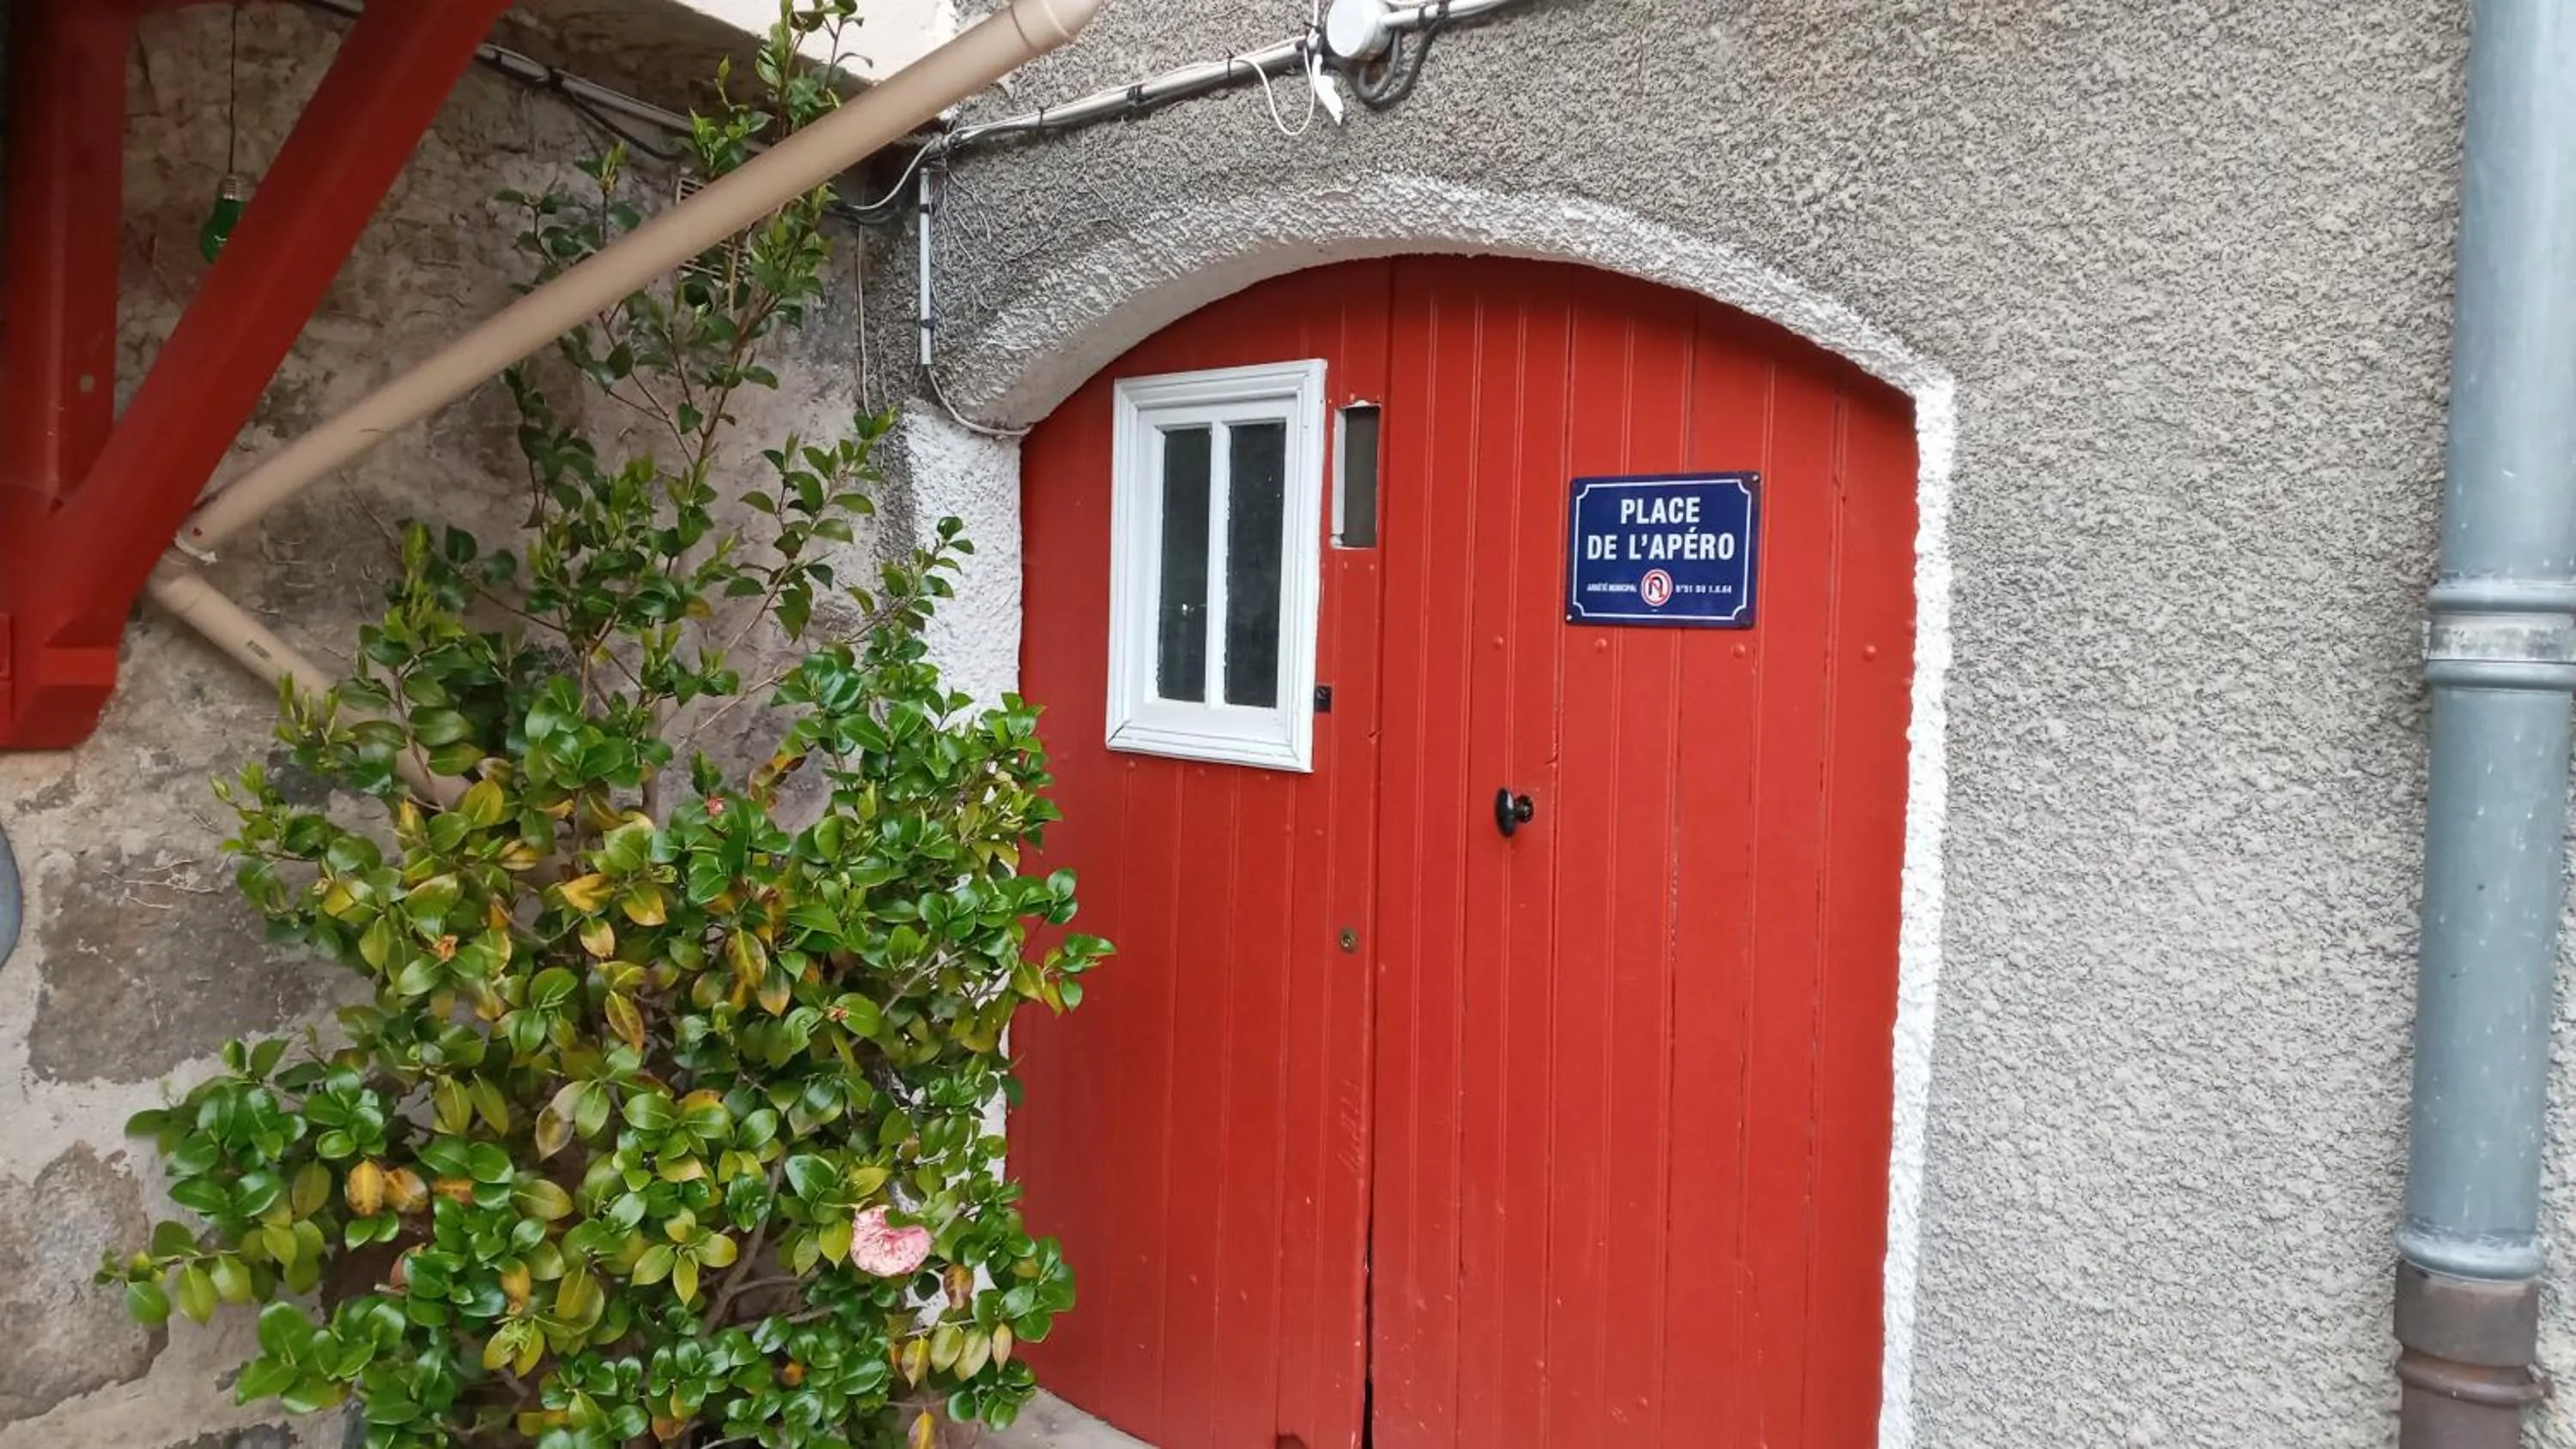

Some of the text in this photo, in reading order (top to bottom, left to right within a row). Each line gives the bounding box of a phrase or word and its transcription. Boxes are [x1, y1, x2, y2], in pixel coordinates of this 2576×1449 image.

[1620, 497, 1700, 524] PLACE
[1587, 527, 1735, 560] DE L'APÉRO
